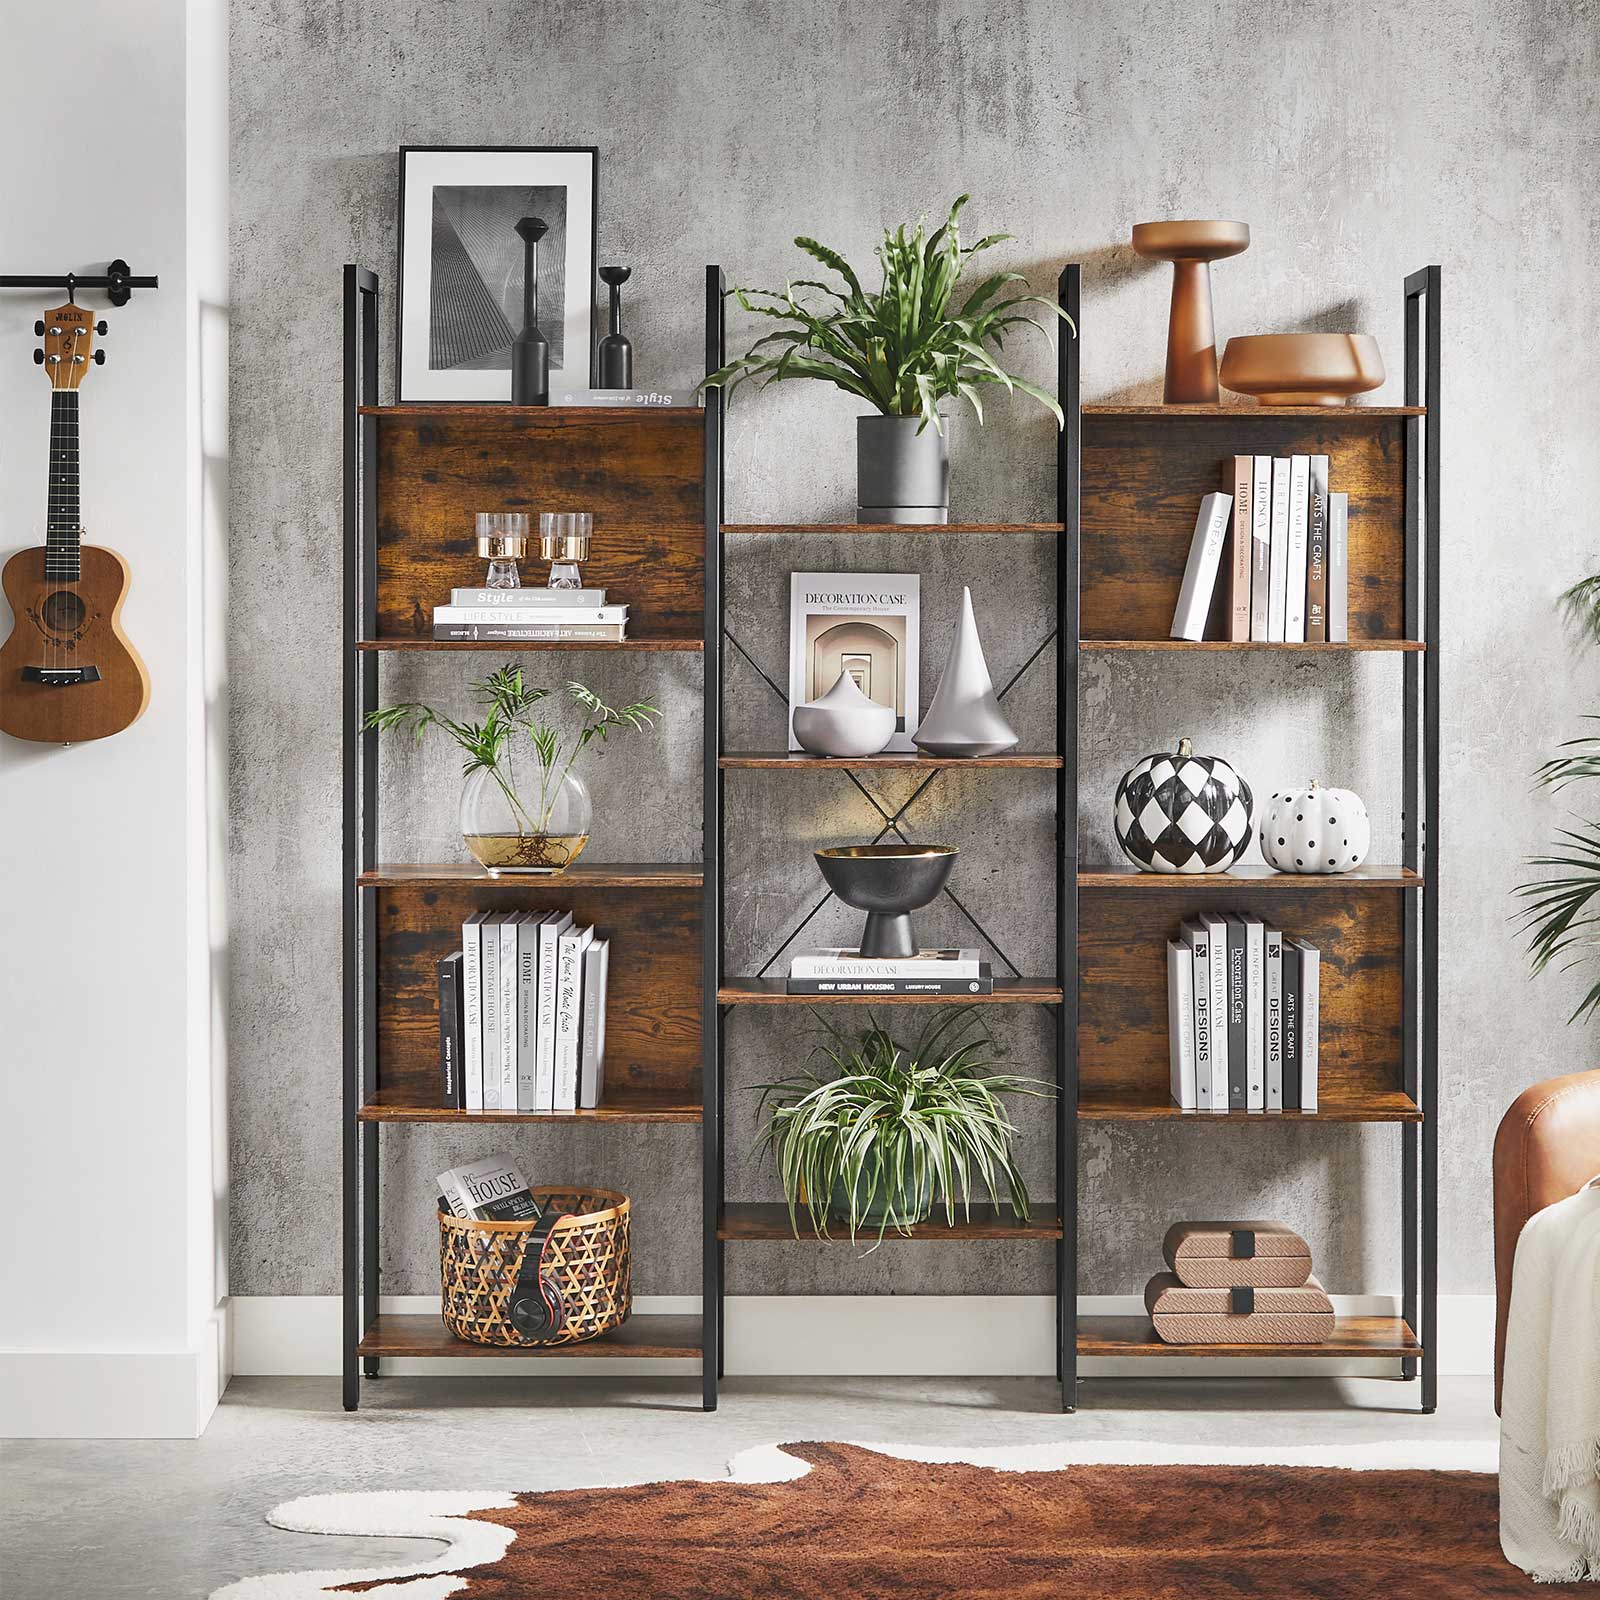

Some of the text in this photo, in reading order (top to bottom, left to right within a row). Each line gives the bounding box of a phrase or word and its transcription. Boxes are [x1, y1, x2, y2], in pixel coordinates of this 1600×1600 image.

[636, 393, 672, 404] Style
[1239, 482, 1248, 515] HOME
[1257, 481, 1267, 528] HOPSCA
[1294, 474, 1305, 549] TRICIA GUILD
[1208, 515, 1223, 558] IDEAS
[1312, 494, 1322, 580] ARTS THE CRAFTS
[478, 593, 514, 604] Style
[806, 593, 907, 604] DECORATION CASE
[464, 612, 486, 622] LIFE
[489, 612, 522, 621] STYLE
[564, 943, 576, 955] The
[468, 942, 477, 1002] DECORATION
[522, 952, 531, 984] HOME
[543, 942, 553, 1003] DECORATION
[562, 956, 574, 976] Count
[813, 965, 897, 975] DECORATION CASE
[1214, 944, 1223, 1007] DECORATION
[487, 939, 495, 1033] THE VINTAGE HOUSE
[560, 976, 572, 984] of
[819, 983, 835, 991] NEW
[837, 983, 861, 991] URBAN
[863, 983, 895, 991] HOUSING
[1234, 948, 1243, 1024] Decoration Case
[562, 987, 573, 1009] Monte
[468, 1004, 477, 1027] CASE
[542, 1005, 552, 1028] CASE
[560, 1011, 573, 1033] Cristo
[1215, 1007, 1224, 1031] CASE
[1198, 998, 1208, 1061] DESIGNS
[1269, 998, 1279, 1061] DESIGNS
[1183, 1031, 1191, 1058] CRAFTS
[445, 1186, 456, 1197] PC
[463, 1173, 476, 1187] PC
[468, 1173, 521, 1203] HOUSE
[451, 1196, 472, 1220] HO
